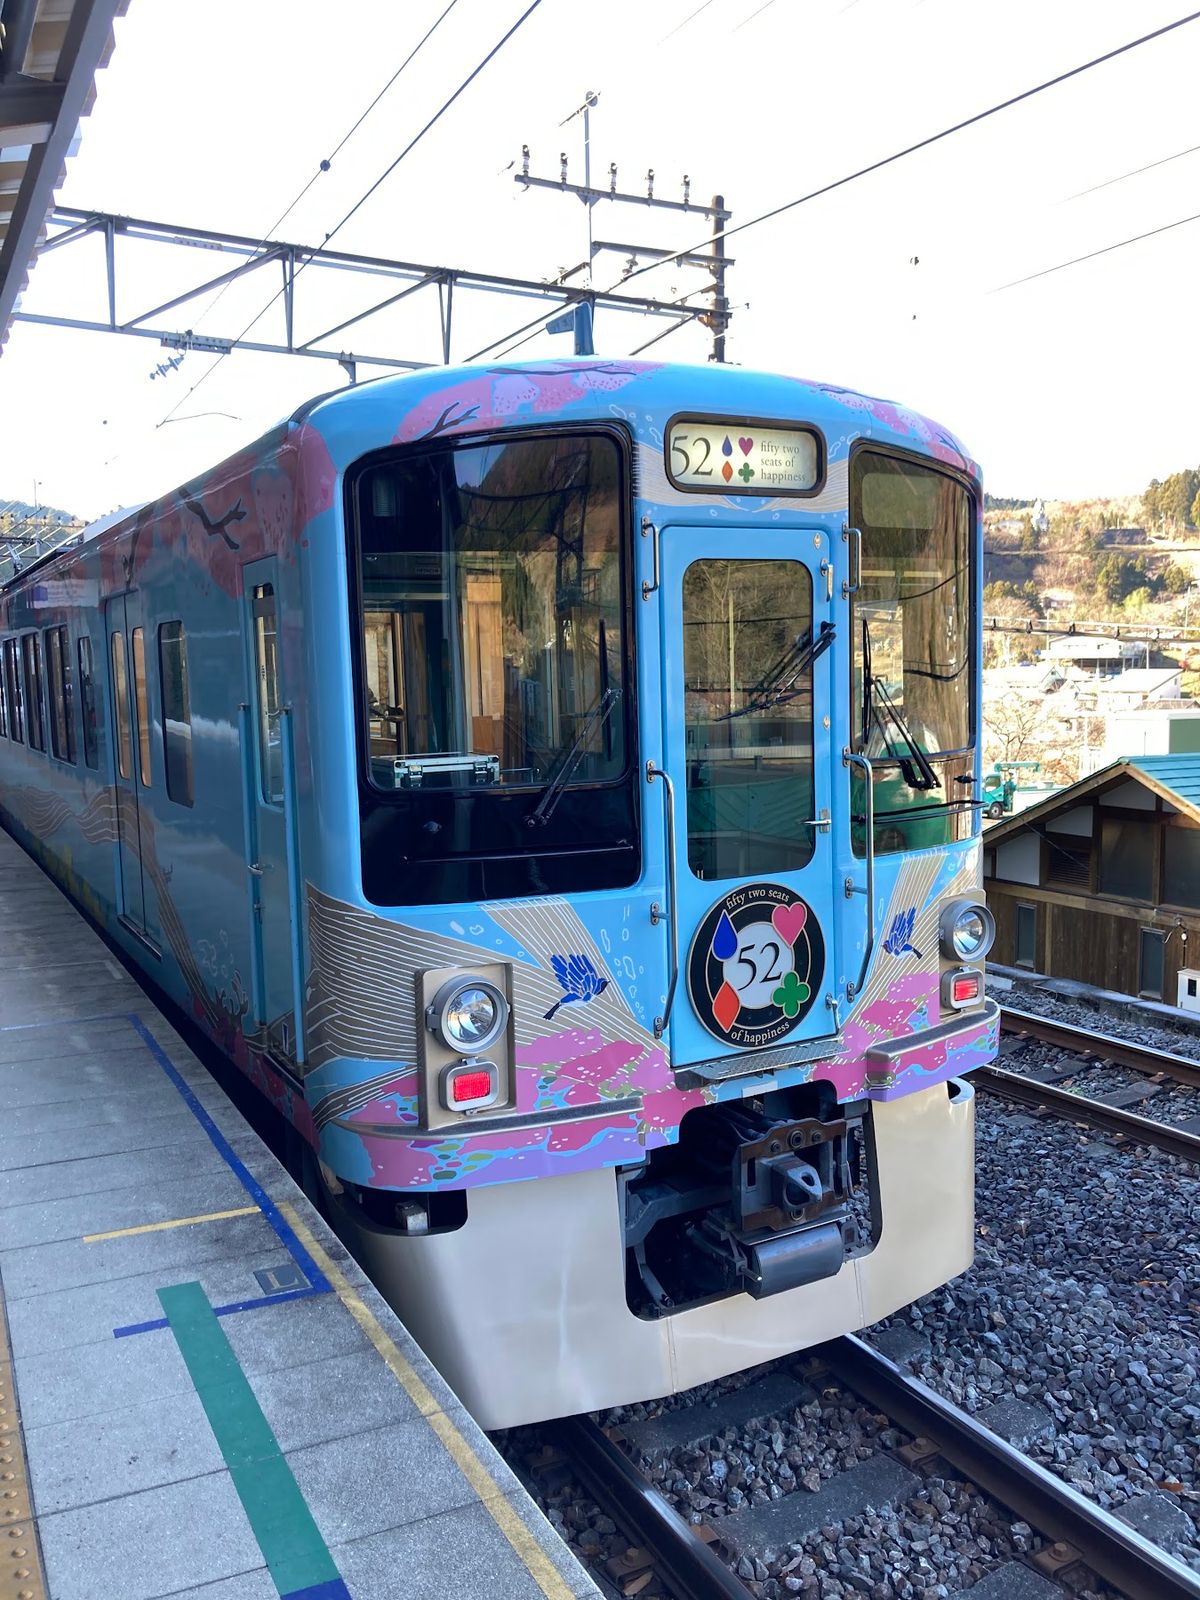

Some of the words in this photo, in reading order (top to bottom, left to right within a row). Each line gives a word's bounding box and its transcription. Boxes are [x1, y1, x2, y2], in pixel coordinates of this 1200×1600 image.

[671, 435, 714, 478] 52
[760, 440, 780, 455] fifty
[782, 445, 800, 455] two
[760, 456, 783, 467] seats
[785, 456, 795, 468] of
[760, 468, 806, 484] happiness
[726, 893, 746, 910] fifty
[748, 889, 766, 899] two
[768, 889, 790, 903] seats
[737, 941, 783, 991] 52
[731, 1030, 744, 1041] of
[744, 1021, 790, 1045] happiness
